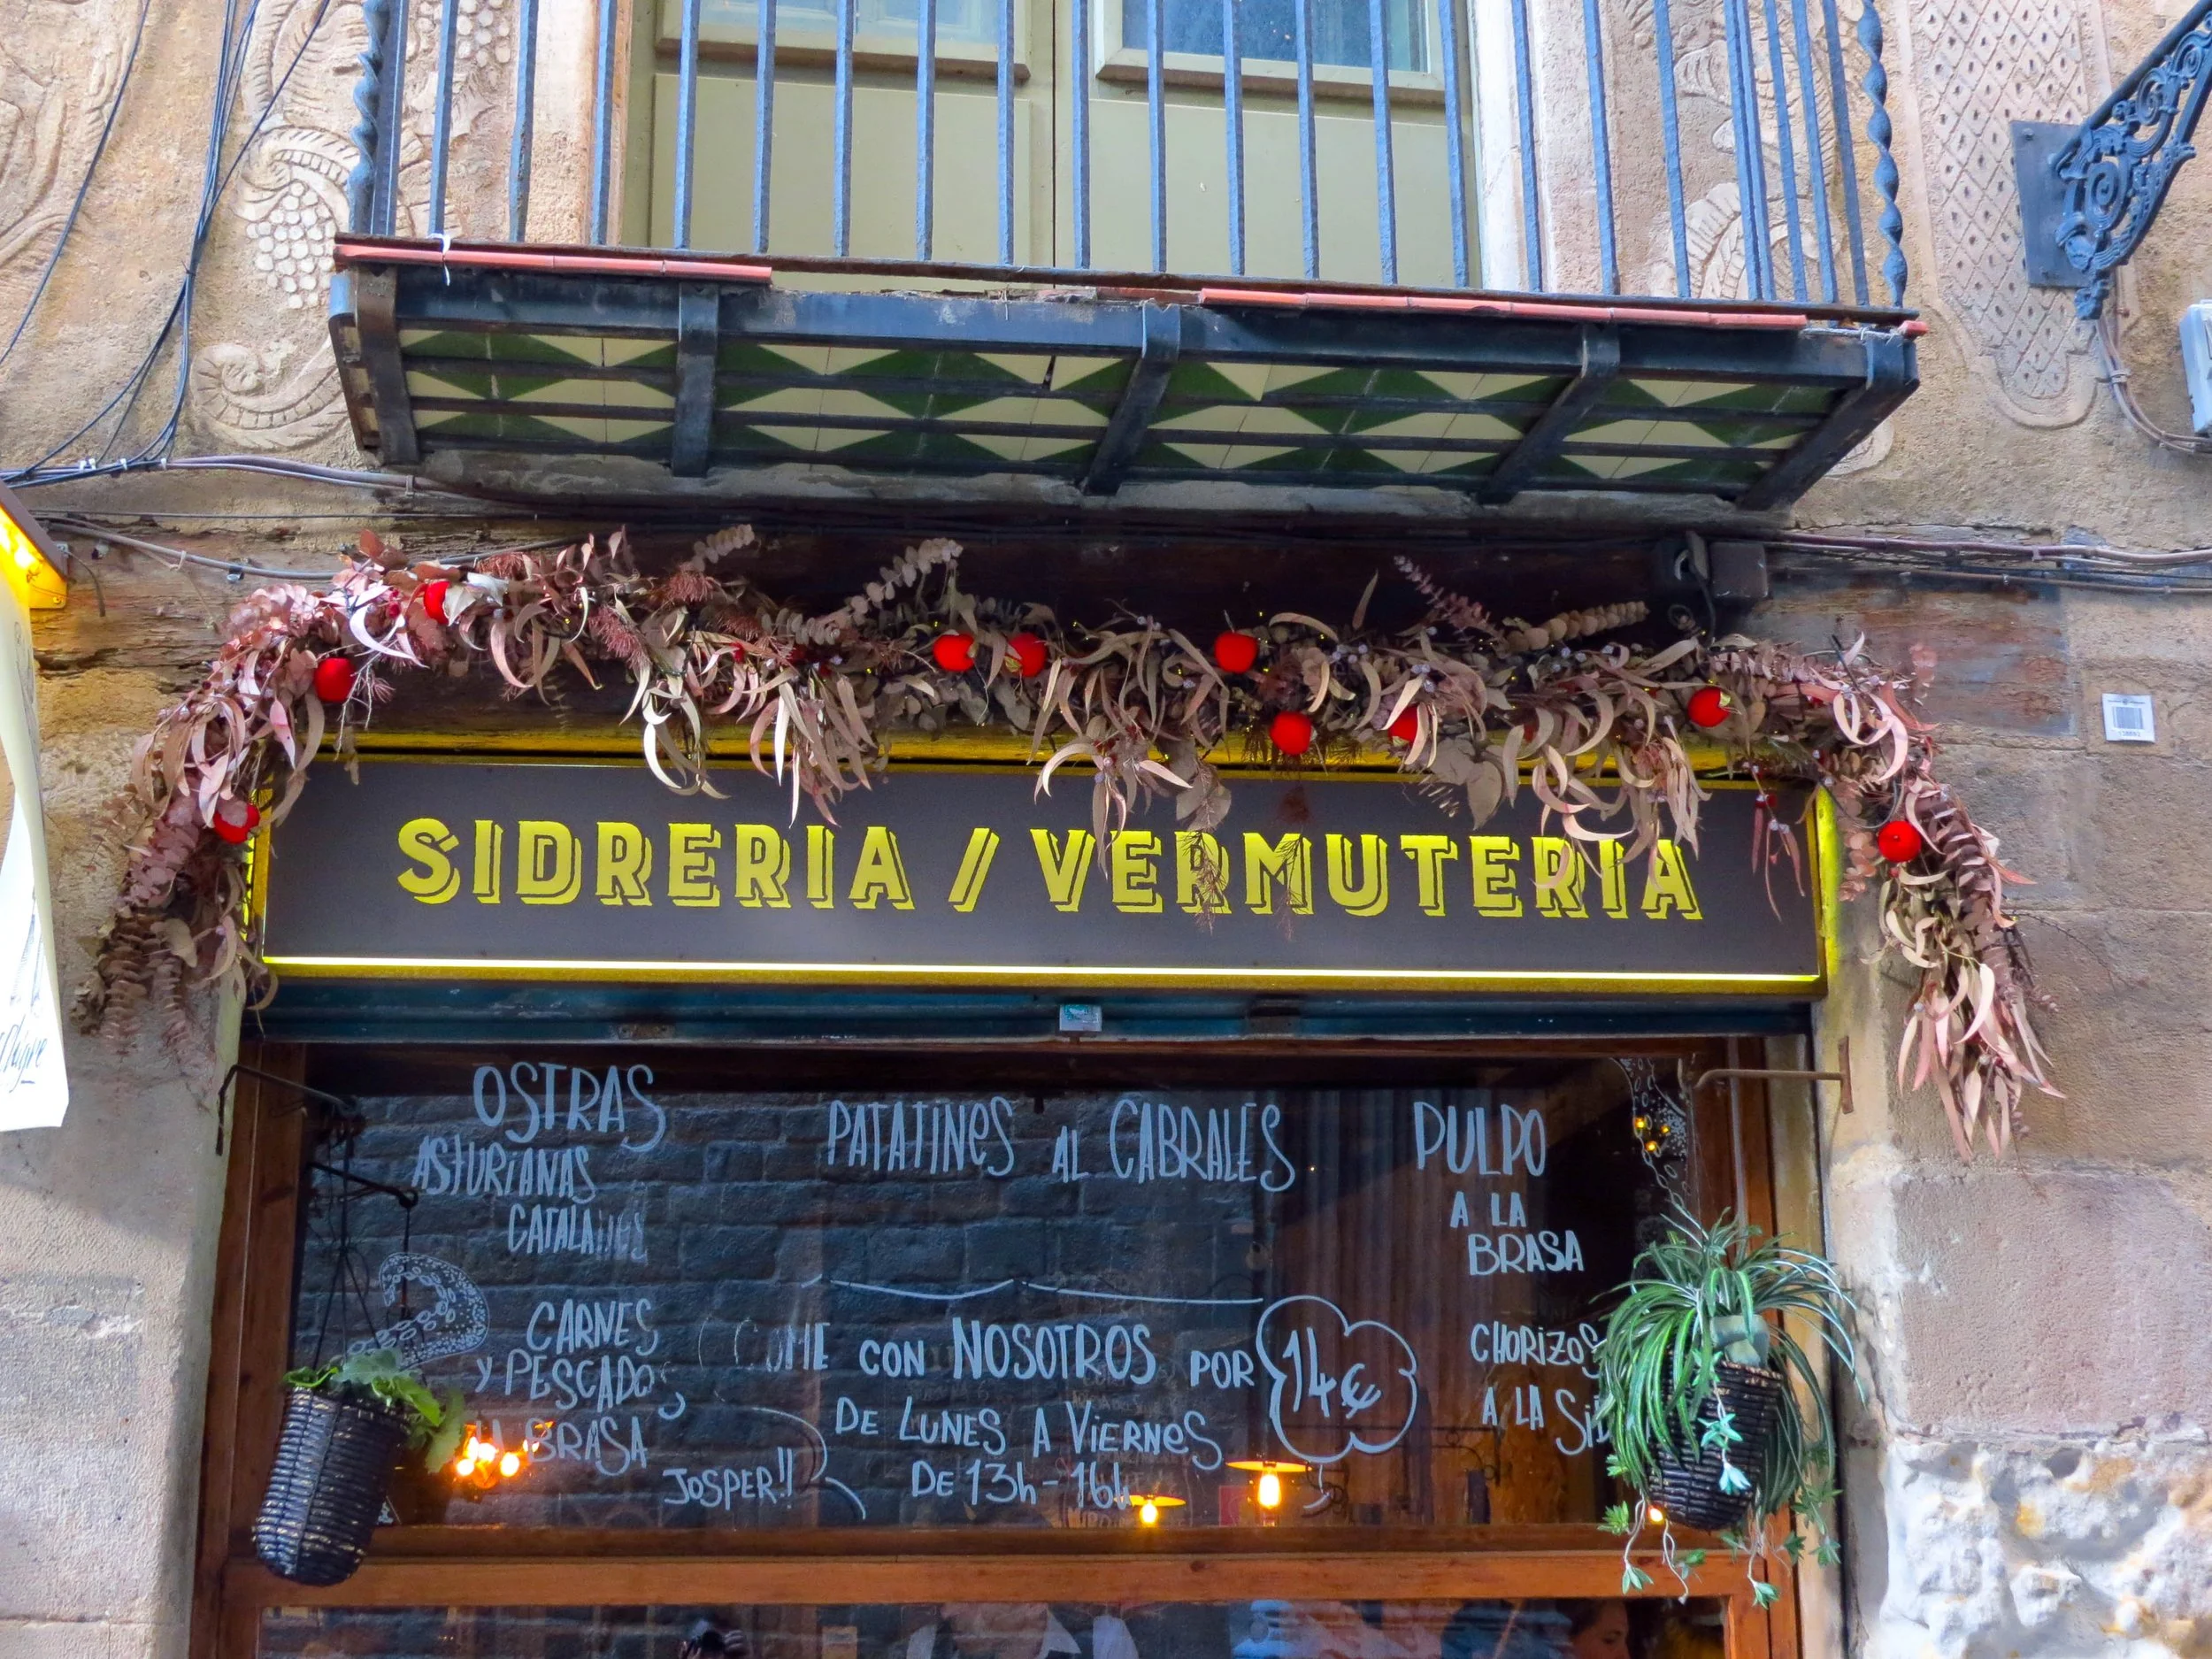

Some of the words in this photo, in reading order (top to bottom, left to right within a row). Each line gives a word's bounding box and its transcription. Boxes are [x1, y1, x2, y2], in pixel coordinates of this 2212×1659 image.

[397, 818, 915, 910] SIDRERIA
[1030, 828, 1703, 920] VERMUTERIA
[472, 1063, 666, 1152] OSTRAS
[1052, 1126, 1089, 1183] AL
[1109, 1100, 1294, 1192] CABRALES
[1414, 1102, 1546, 1176] PULPO
[1450, 1192, 1469, 1228] A
[1492, 1192, 1526, 1227] LA
[1468, 1230, 1584, 1276] BRASA
[526, 1297, 659, 1356] CARNES
[859, 1339, 926, 1377] CON
[952, 1317, 1157, 1385] NOSOTROS
[1190, 1350, 1255, 1387] POR
[1282, 1326, 1382, 1420] 14€
[835, 1397, 879, 1435] DE
[899, 1395, 1006, 1455] LUNES
[1033, 1407, 1051, 1457] A
[1482, 1386, 1498, 1425] A
[1515, 1385, 1544, 1430] LA
[526, 1417, 649, 1476] BRASA
[662, 1447, 794, 1508] JOSPER!!
[912, 1461, 954, 1497] DE
